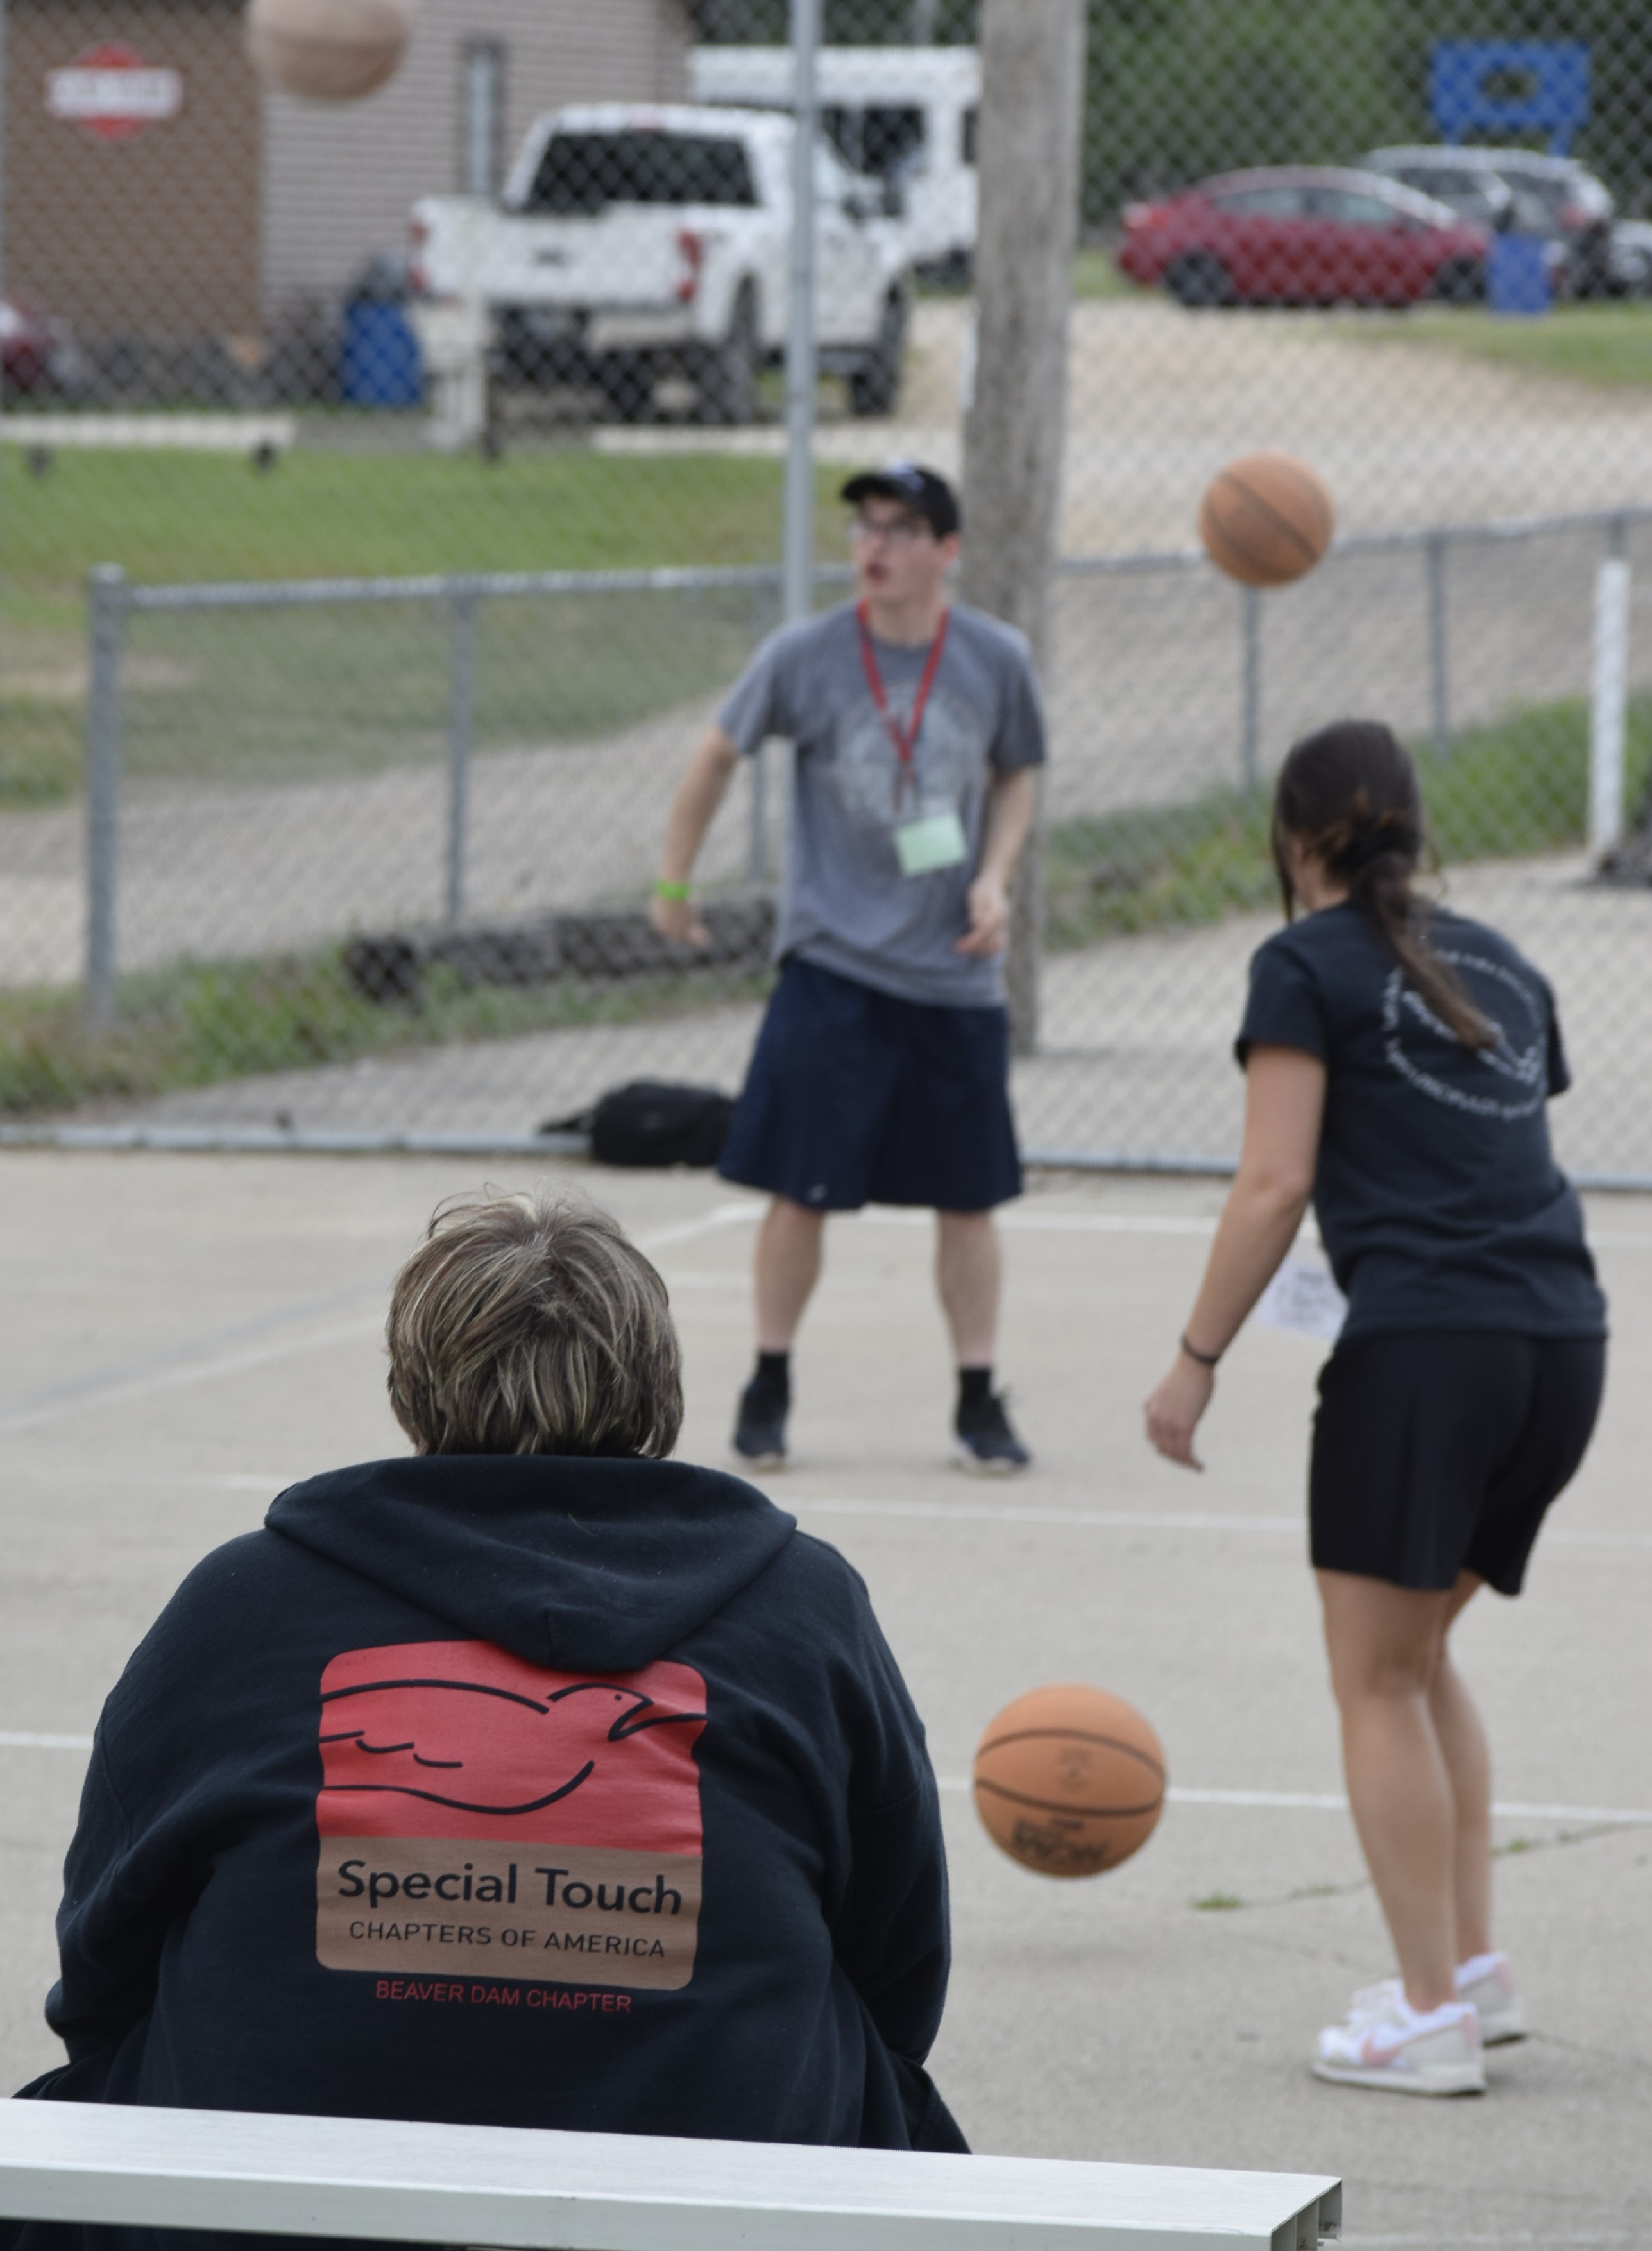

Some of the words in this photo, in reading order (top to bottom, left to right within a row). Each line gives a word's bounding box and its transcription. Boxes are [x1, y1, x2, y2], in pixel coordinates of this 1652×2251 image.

[337, 1860, 516, 1908] Special
[535, 1867, 682, 1915] Touch
[349, 1921, 492, 1946] CHAPTERS
[500, 1928, 537, 1948] OF
[543, 1931, 665, 1958] AMERICA
[375, 1980, 464, 2004] BEAVER
[471, 1985, 520, 2007] DAM
[526, 1989, 631, 2014] CHAPTER
